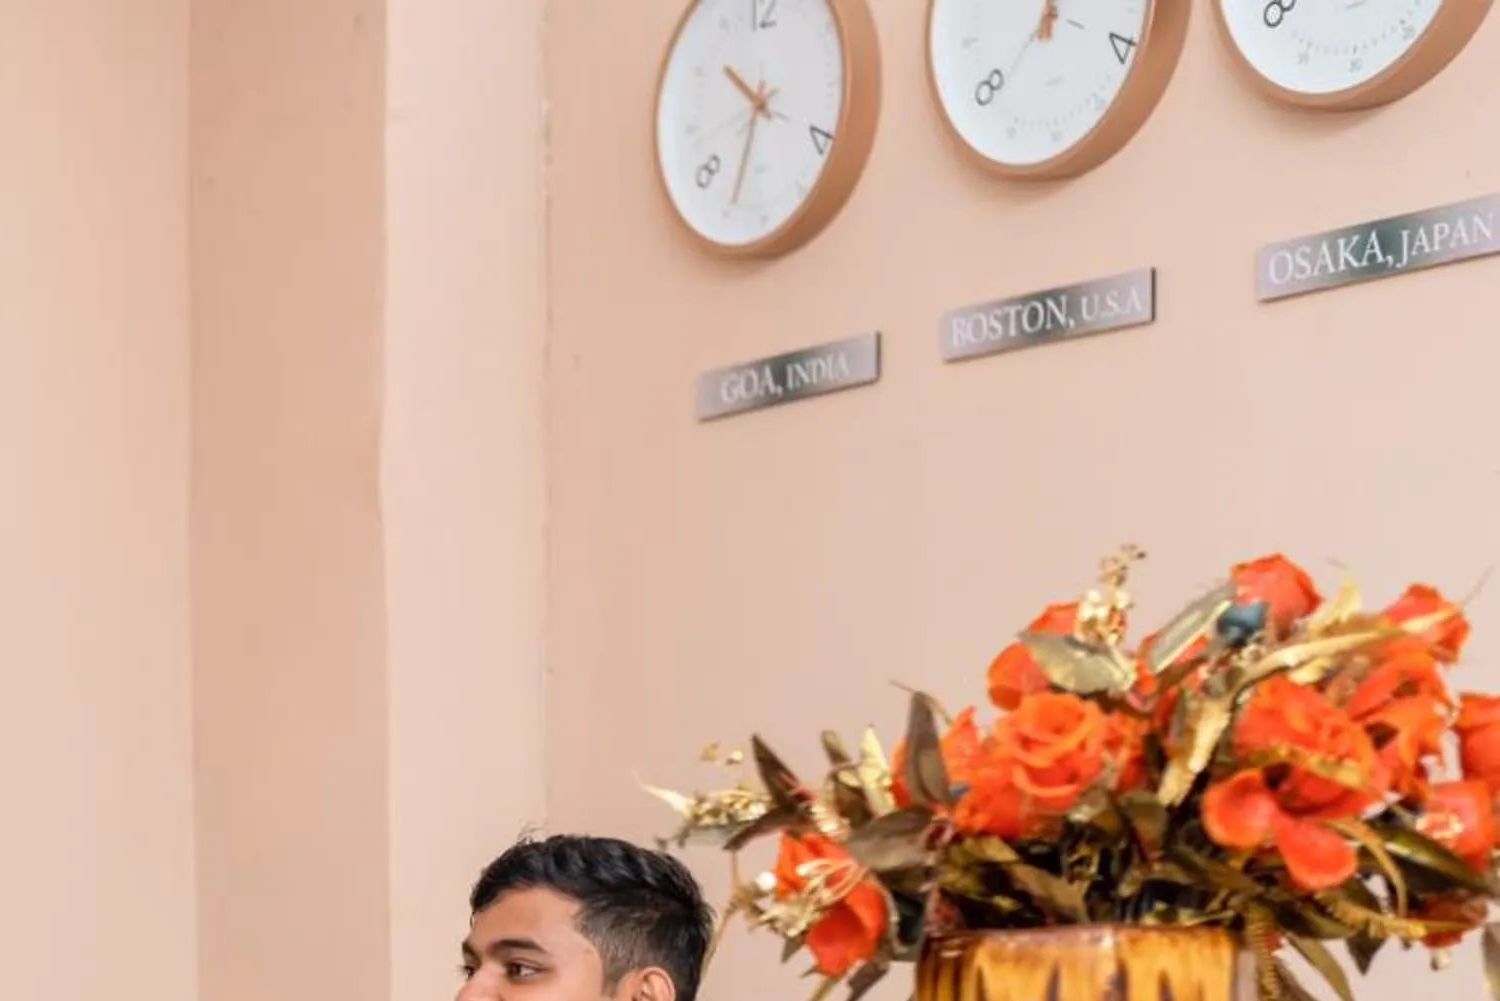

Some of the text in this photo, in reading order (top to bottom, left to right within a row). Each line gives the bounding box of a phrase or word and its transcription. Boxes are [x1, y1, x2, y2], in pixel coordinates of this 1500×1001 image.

[752, 0, 778, 32] 12
[1108, 32, 1137, 65] 4
[975, 68, 1004, 106] 8
[809, 124, 835, 156] 4
[695, 153, 721, 189] 8
[1268, 211, 1494, 284] OSAKA, JAPAN
[951, 294, 1076, 348] BOSTON,
[719, 352, 849, 404] GOA, INDIA
